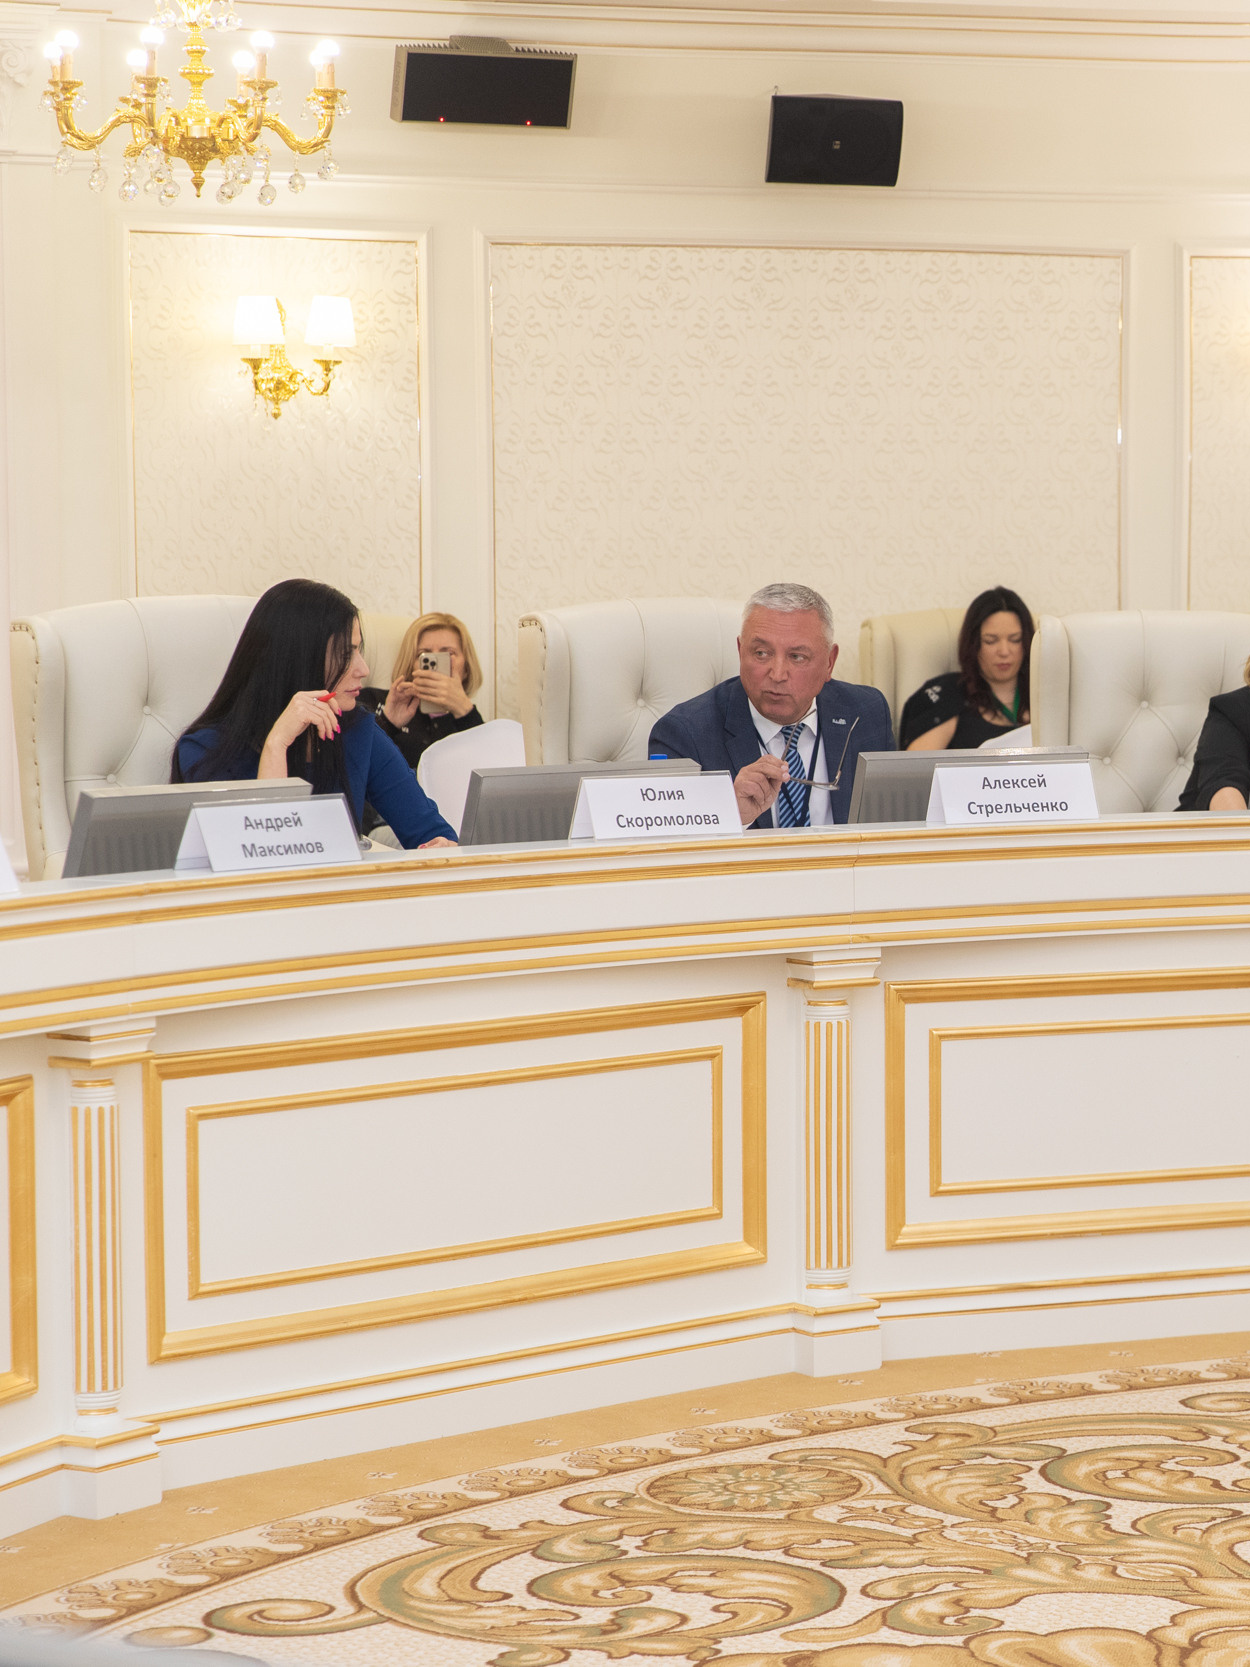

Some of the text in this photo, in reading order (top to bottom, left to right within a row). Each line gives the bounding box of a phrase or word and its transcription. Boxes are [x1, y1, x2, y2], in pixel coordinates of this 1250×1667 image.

[981, 773, 1047, 790] Алексей
[639, 786, 685, 802] Юлия
[967, 801, 1069, 818] Стрельченко
[244, 811, 303, 832] Андрей
[615, 813, 720, 831] Скоромолова
[241, 841, 325, 858] Максимов
